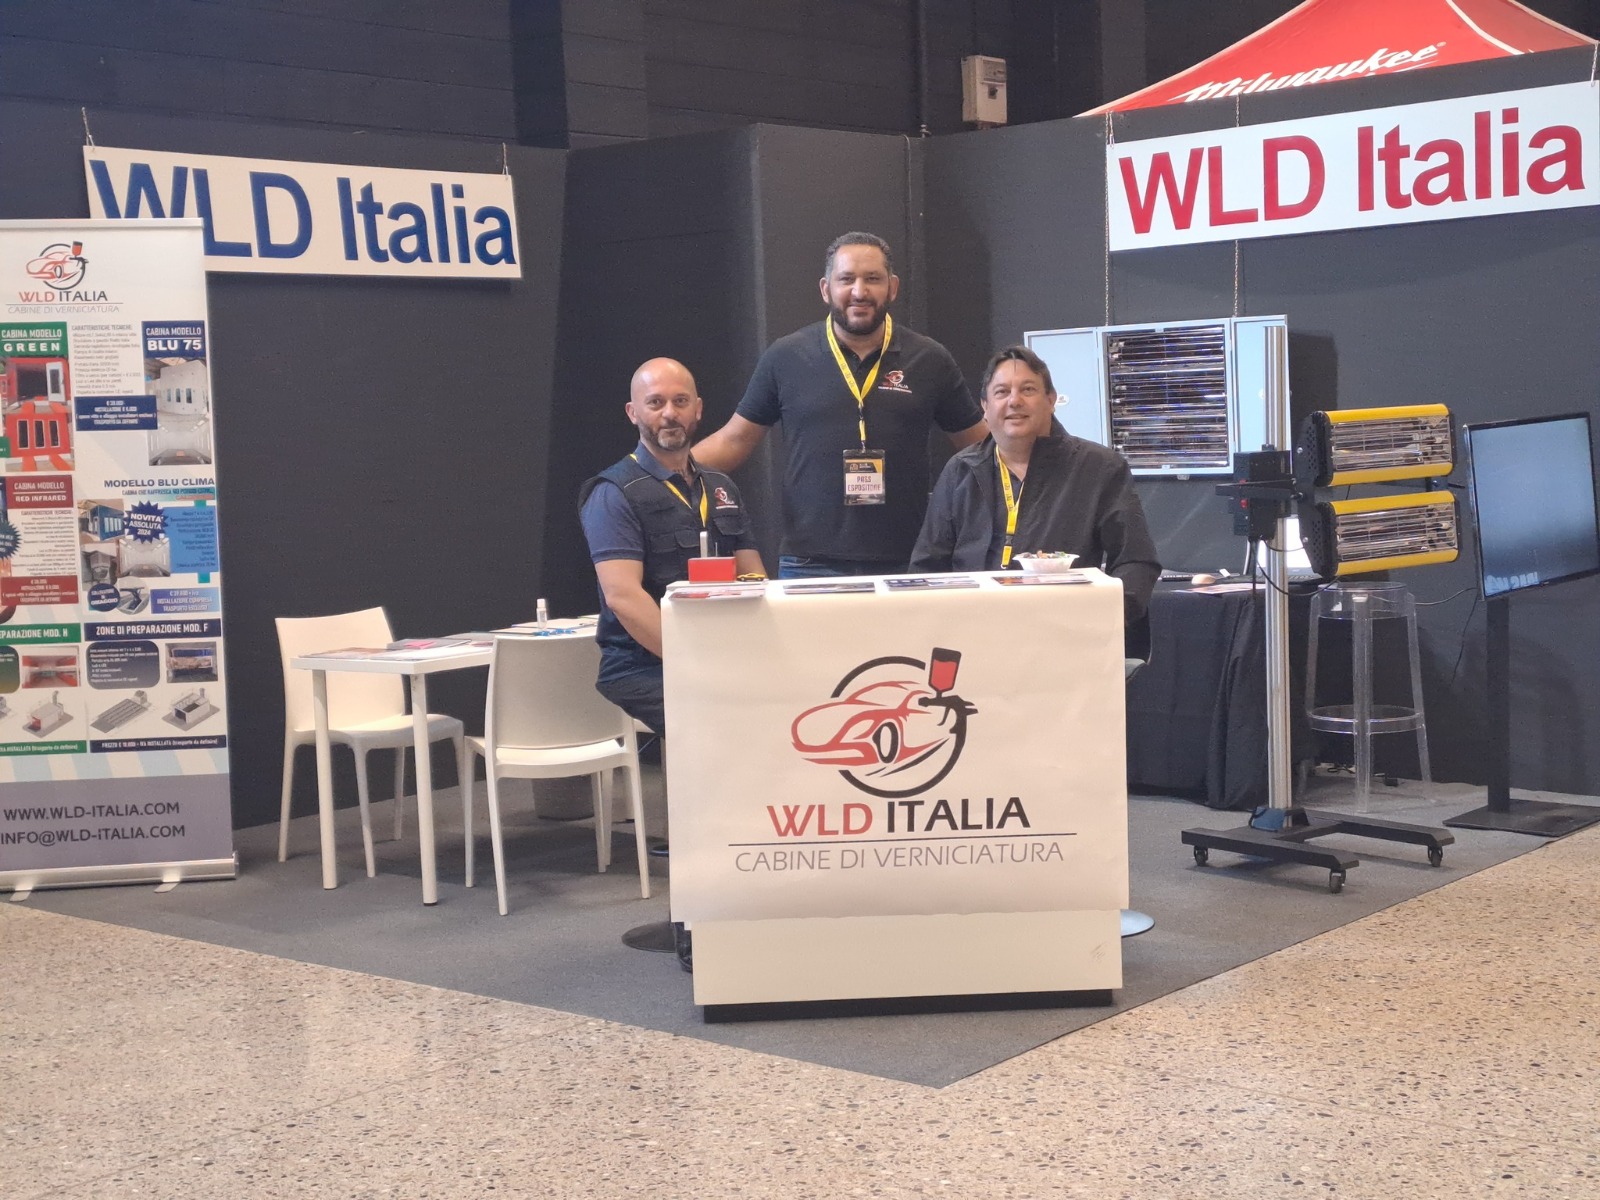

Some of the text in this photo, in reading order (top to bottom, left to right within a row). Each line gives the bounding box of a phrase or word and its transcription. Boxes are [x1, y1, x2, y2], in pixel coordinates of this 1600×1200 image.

[1168, 46, 1438, 102] Milwaukee
[1118, 107, 1586, 235] WLD Italia
[89, 159, 517, 265] WLD Italia
[19, 291, 108, 303] WLD ITALIA
[8, 306, 120, 314] CABINE DI VERNICIATURA
[1, 328, 62, 338] CABINA MODELLO
[146, 327, 202, 336] CABINA MODELLO
[3, 343, 60, 352] GREEN
[147, 339, 202, 351] BLU 75
[104, 478, 215, 488] MODELLO BLU CLIMA
[857, 475, 872, 483] PASS
[14, 481, 64, 490] CABINA MODELLO
[128, 521, 162, 529] ASSOLUTA
[43, 629, 61, 638] MOD.
[96, 623, 208, 635] ZONE DI PREPARAZIONE MOD. F
[4, 802, 180, 821] WWW.WLD-ITALIA.COM
[767, 796, 1031, 837] WLD ITALIA
[735, 842, 1065, 872] CABINE DI VERNICIATURA
